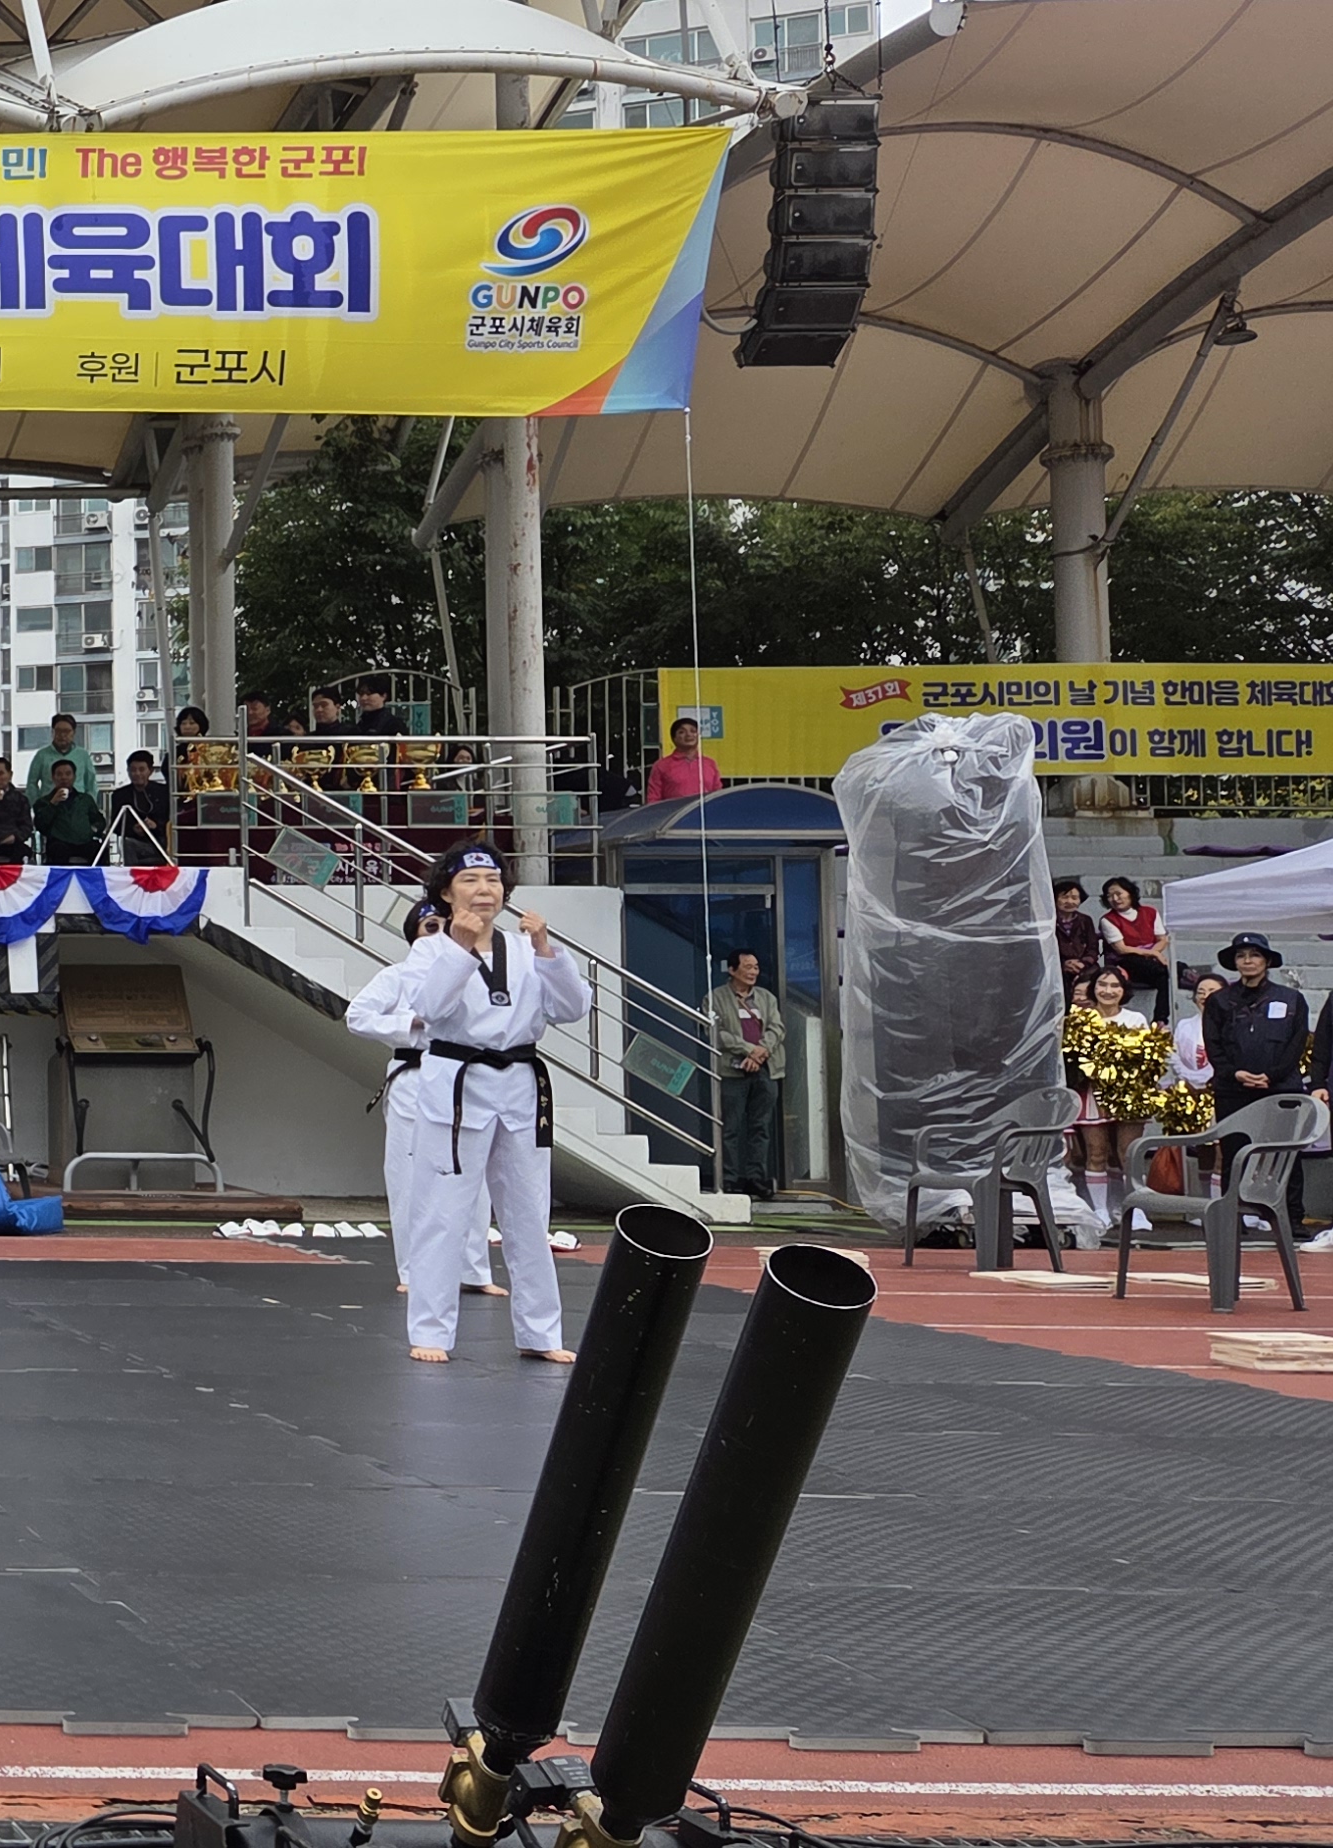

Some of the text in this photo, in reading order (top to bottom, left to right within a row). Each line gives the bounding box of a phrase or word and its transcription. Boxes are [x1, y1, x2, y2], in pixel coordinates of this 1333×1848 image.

[75, 147, 143, 179] The
[151, 144, 268, 181] 행복한
[279, 144, 368, 179] 군포!
[471, 283, 586, 311] GUNPO
[468, 315, 581, 338] 군포시체육회
[467, 338, 579, 350] Gunpo City Sports Council
[76, 348, 287, 387] 후원 군포시
[922, 680, 1061, 707] 군포시민의
[1068, 679, 1098, 706] 날
[1103, 679, 1156, 706] 기념
[1161, 679, 1240, 706] 한마음
[1146, 728, 1207, 757] 함께
[1214, 728, 1313, 758] 합니다!
